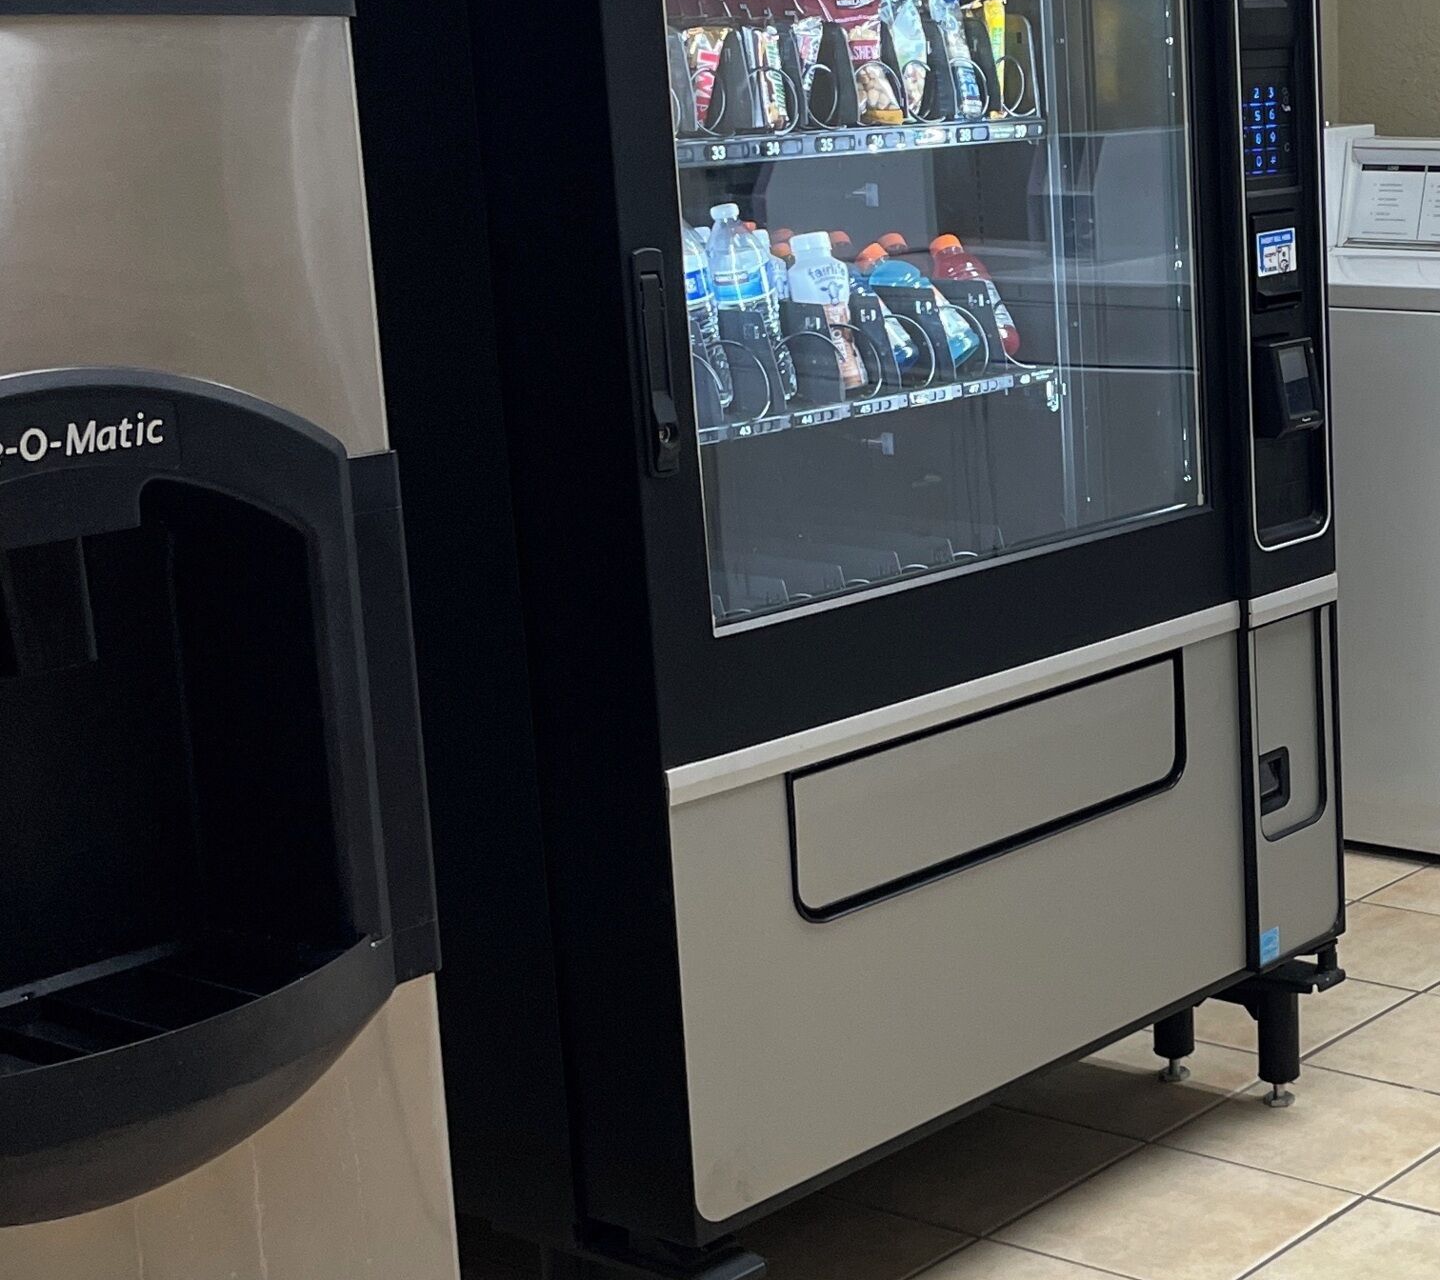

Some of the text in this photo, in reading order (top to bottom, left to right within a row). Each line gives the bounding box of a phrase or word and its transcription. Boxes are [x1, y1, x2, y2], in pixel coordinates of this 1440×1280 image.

[1254, 88, 1260, 99] 2
[1268, 87, 1275, 99] 3
[1254, 110, 1261, 121] 5
[1269, 109, 1275, 120] 6
[1256, 133, 1262, 144] 8
[1270, 132, 1276, 143] 9
[767, 142, 780, 156] 34
[820, 138, 834, 152] 35
[711, 145, 726, 160] 33
[801, 413, 814, 425] 44
[739, 424, 752, 437] 43
[0, 412, 164, 462] -O-Matic
